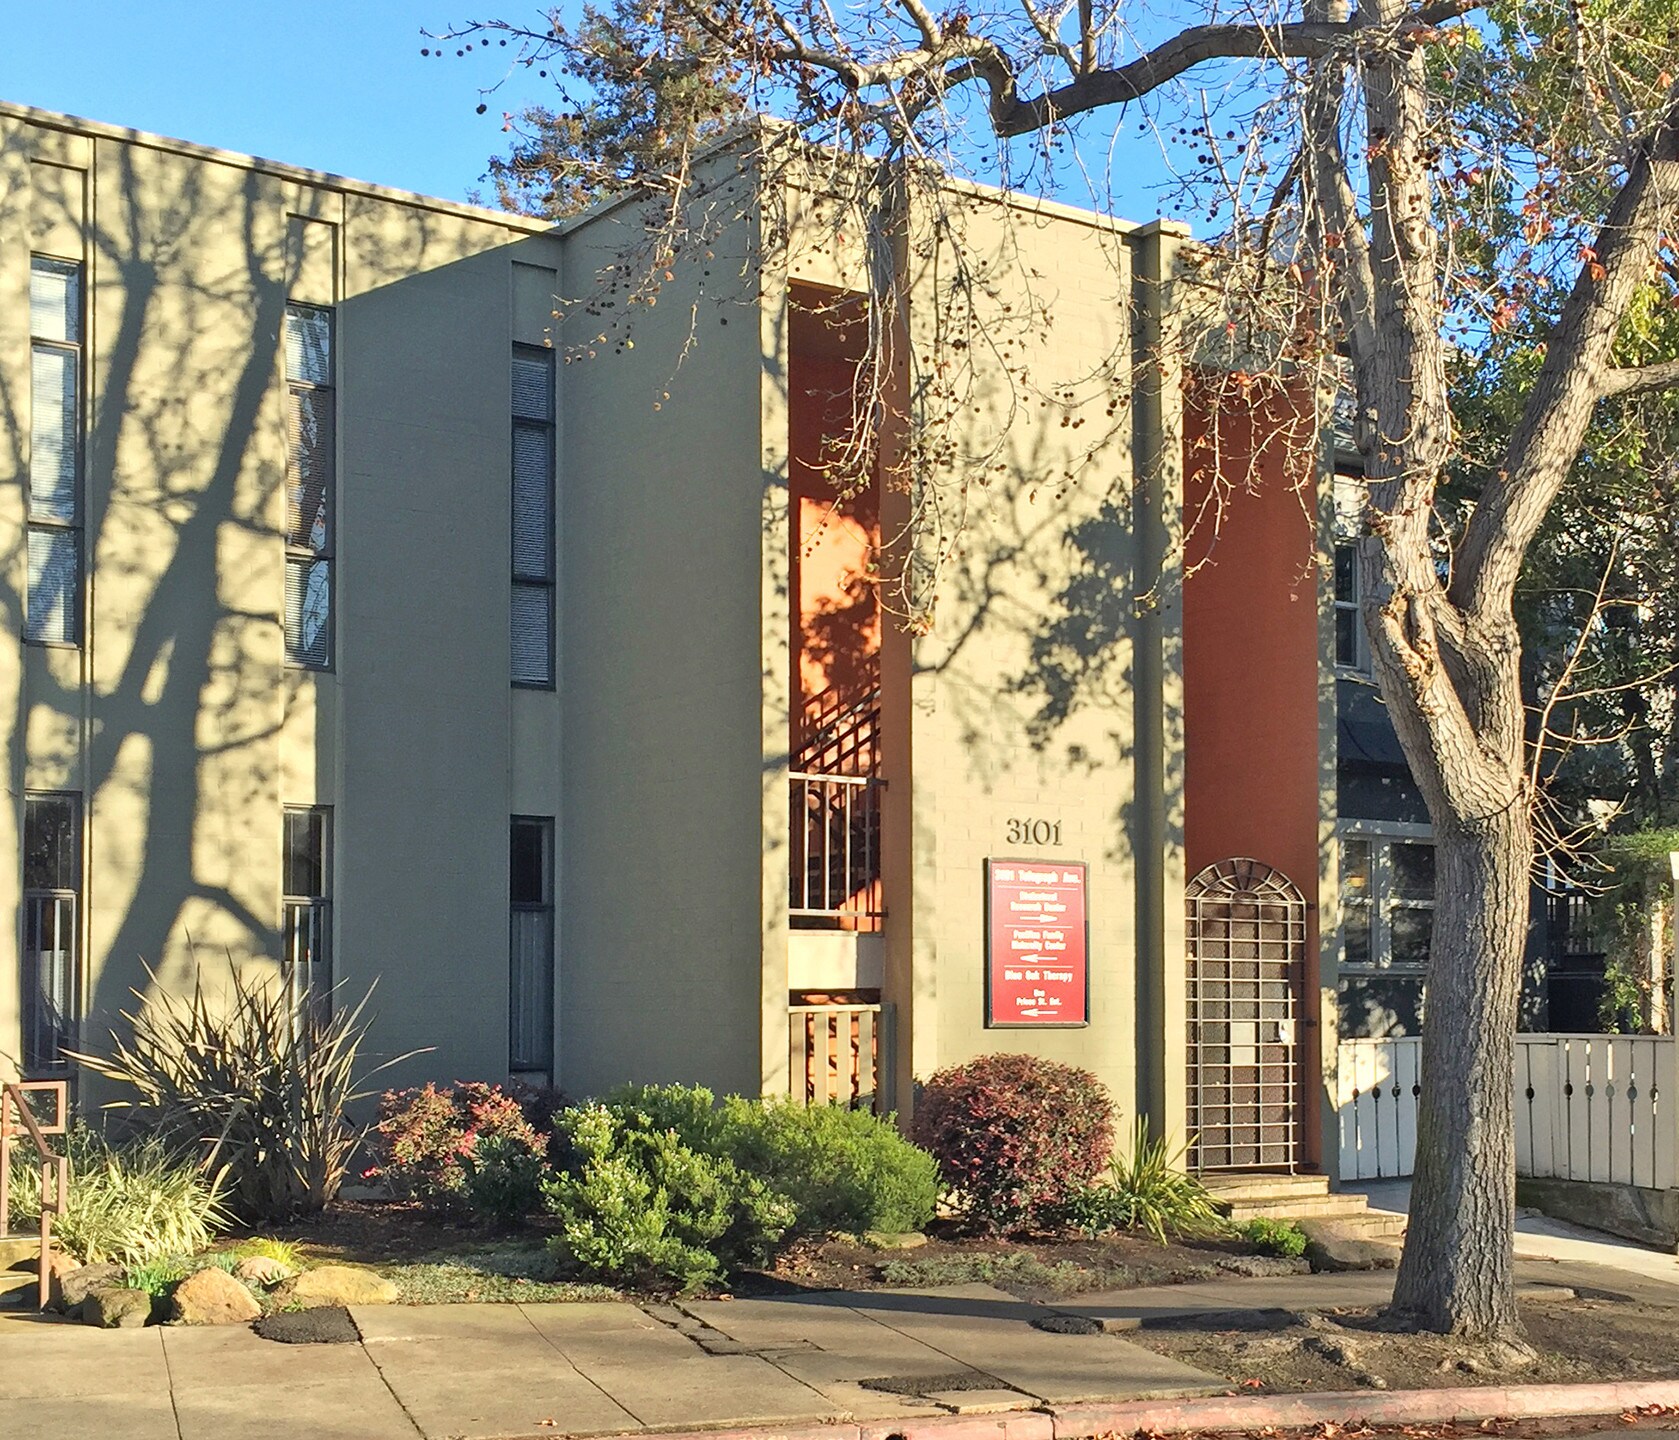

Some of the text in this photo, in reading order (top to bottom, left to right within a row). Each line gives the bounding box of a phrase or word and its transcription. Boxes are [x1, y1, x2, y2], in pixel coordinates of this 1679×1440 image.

[1006, 817, 1063, 846] 3101
[1018, 869, 1059, 885] Telegraph
[1044, 940, 1067, 951] Center
[1004, 969, 1073, 983] Blue Oak Therapy
